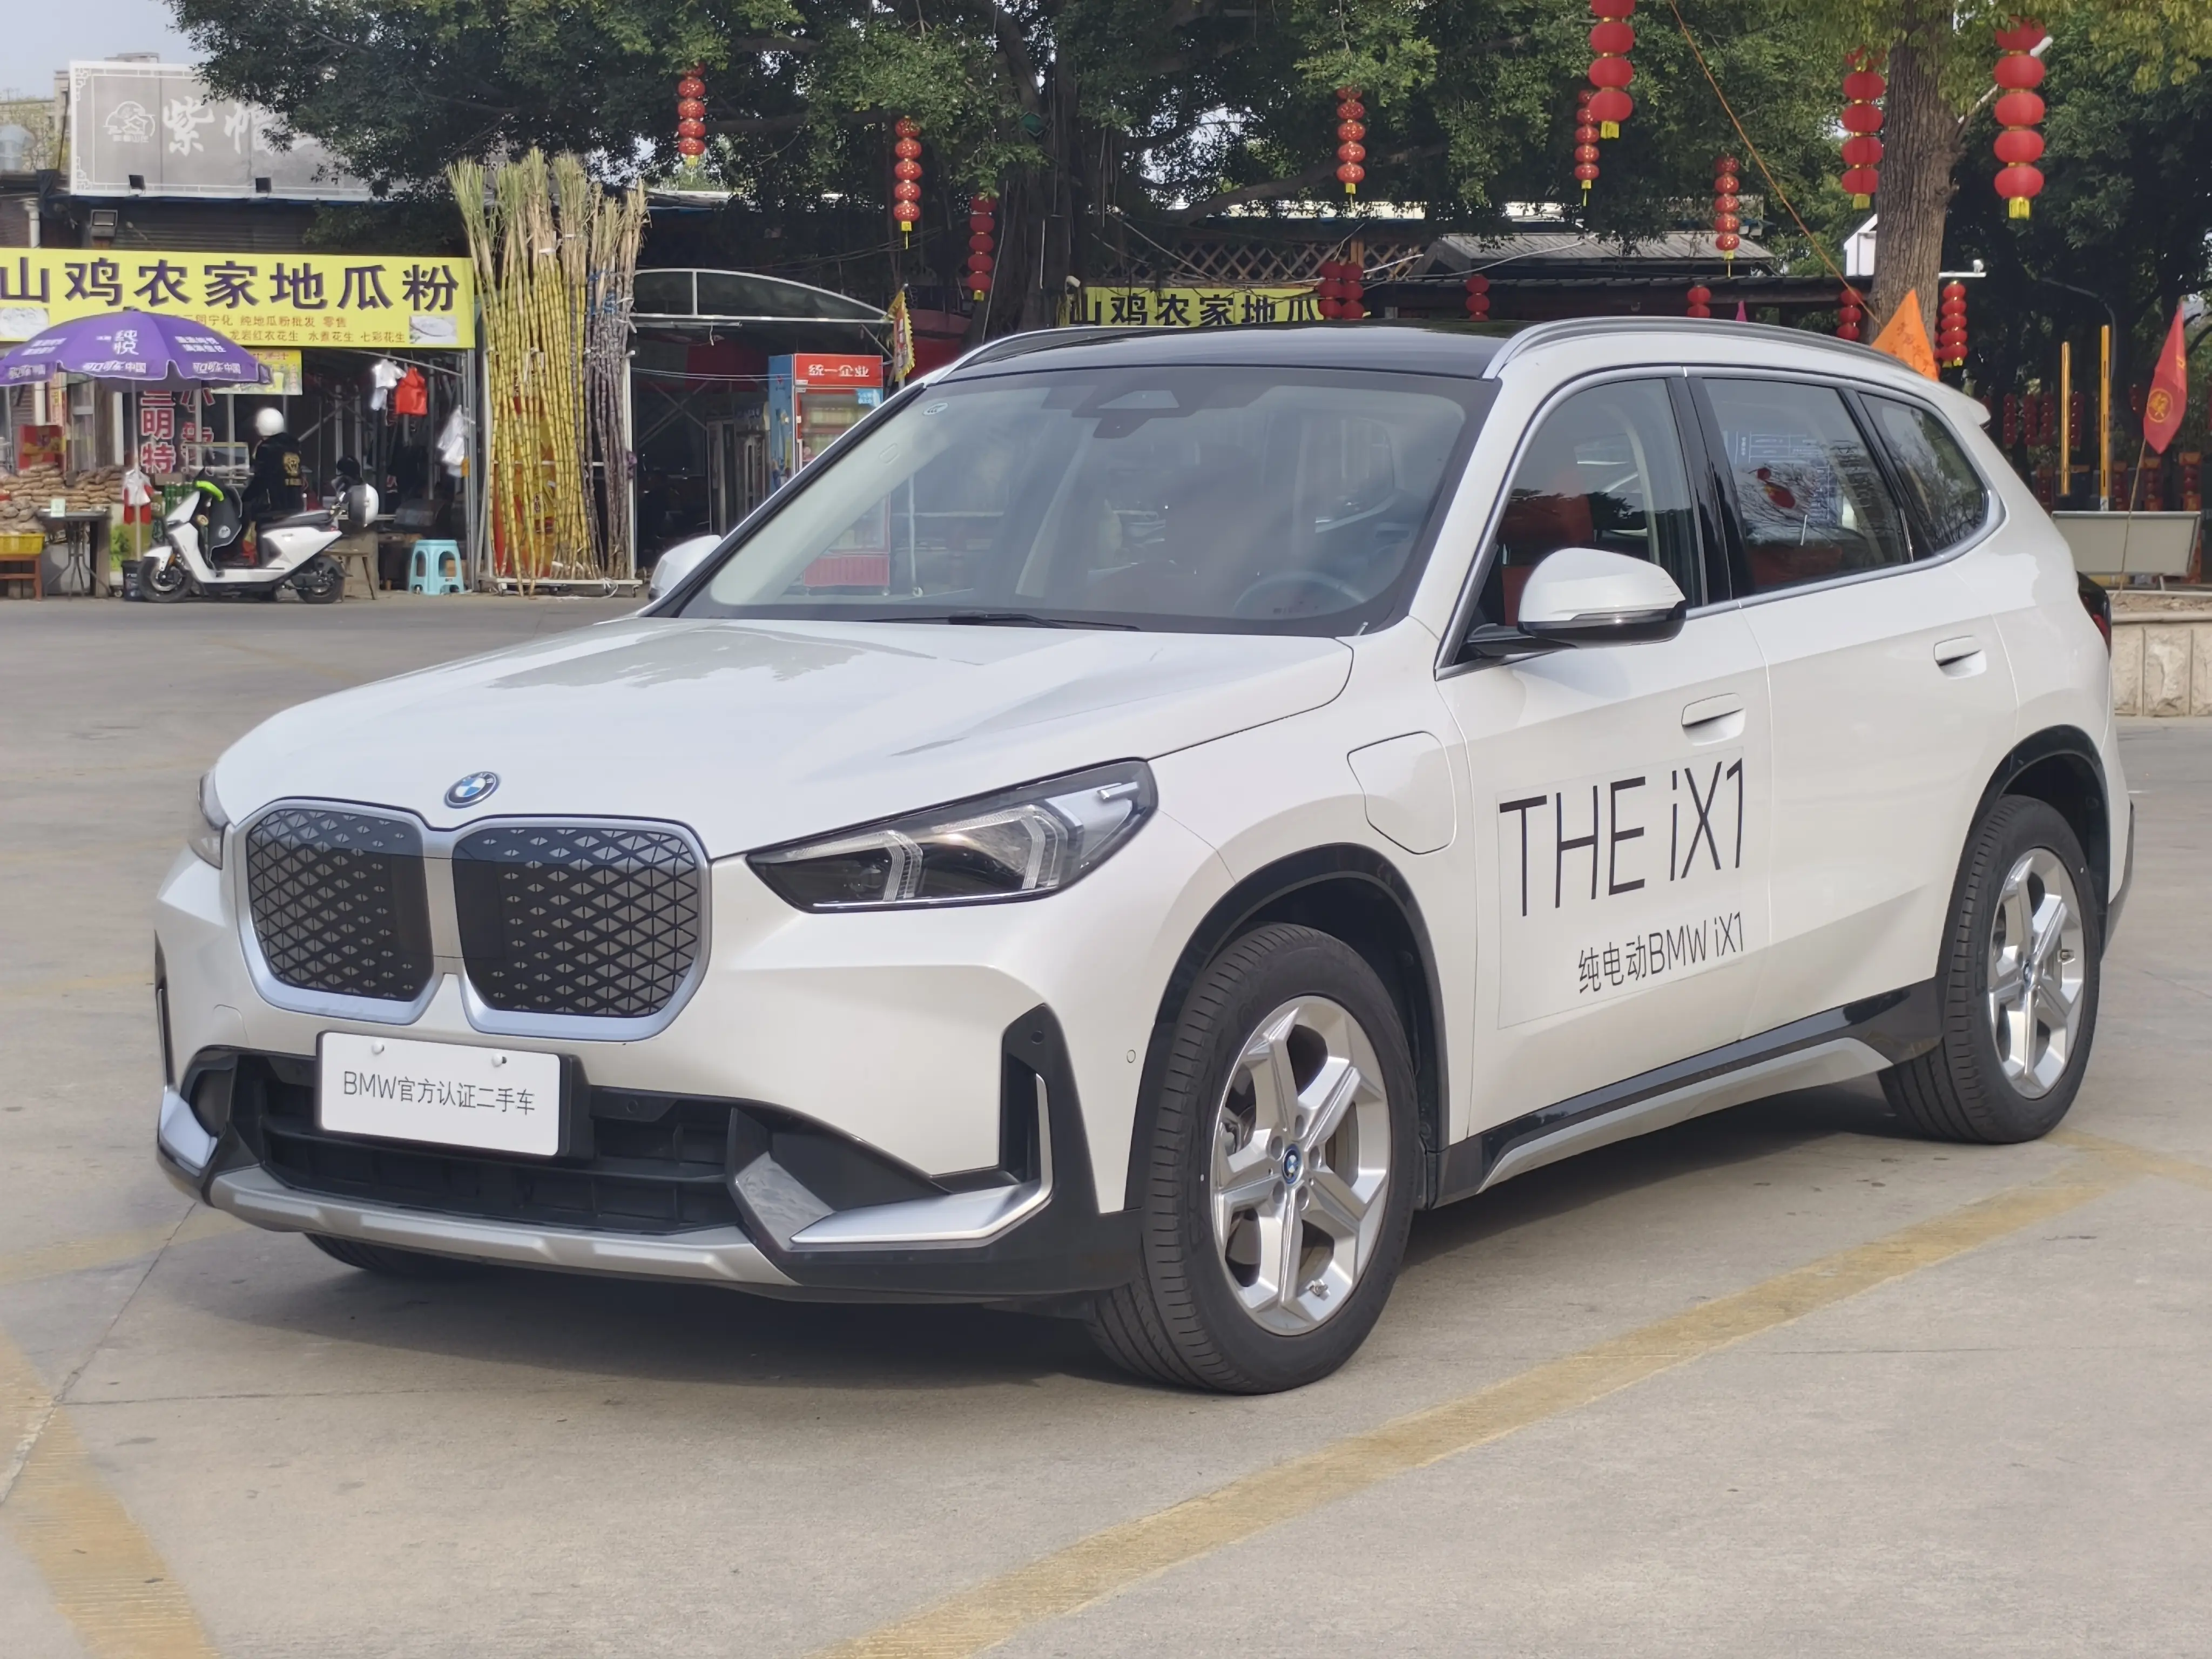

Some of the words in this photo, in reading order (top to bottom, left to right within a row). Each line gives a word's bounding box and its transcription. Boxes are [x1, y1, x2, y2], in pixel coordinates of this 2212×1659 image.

[0, 257, 459, 312] 山鸡农家地瓜粉
[1070, 293, 1316, 326] 山鸡农家地瓜
[808, 363, 870, 377] 统一企业
[1499, 775, 1647, 917] THE
[1670, 757, 1743, 882] iX1
[1714, 911, 1743, 957] iX1
[343, 1070, 535, 1115] BMW官方认证二手车
